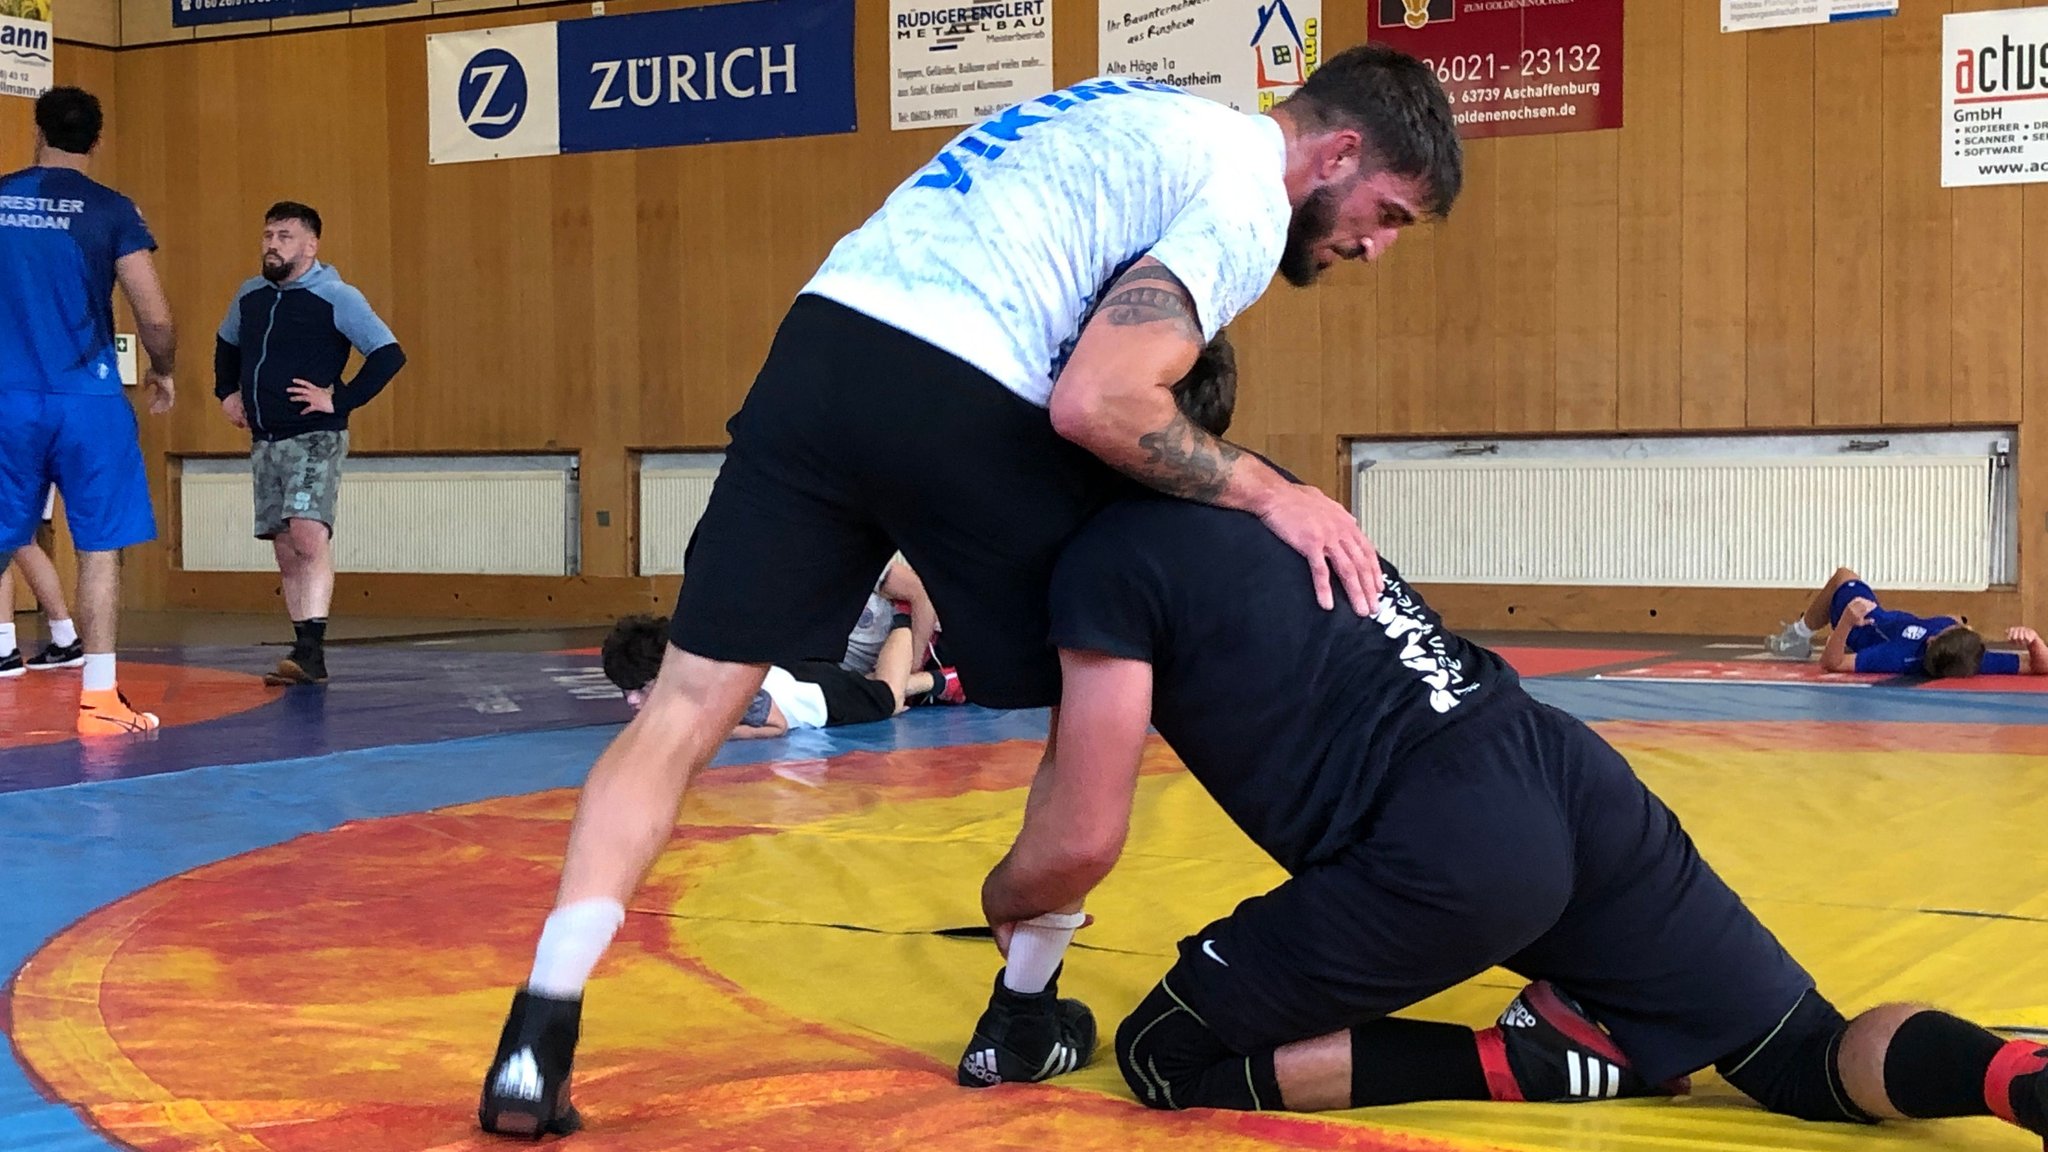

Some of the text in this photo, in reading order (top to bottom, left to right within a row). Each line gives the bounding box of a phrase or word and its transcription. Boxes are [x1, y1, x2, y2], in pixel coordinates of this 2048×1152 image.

[897, 0, 1044, 28] RÜDIGER ENGLERT
[1464, 4, 1485, 13] ZUM
[897, 17, 1045, 39] METALLBAU
[1107, 20, 1121, 33] Ihr
[1521, 44, 1601, 76] 23132
[1106, 61, 1127, 74] Alte
[589, 44, 797, 110] ZÜRICH
[1461, 87, 1500, 103] 63739
[1504, 82, 1601, 101] Aschaffenburg
[1953, 107, 2002, 122] GmbH
[1964, 123, 2020, 134] KOPIERER
[1964, 134, 2015, 145] SCANNER
[1964, 145, 2024, 157] SOFTWARE
